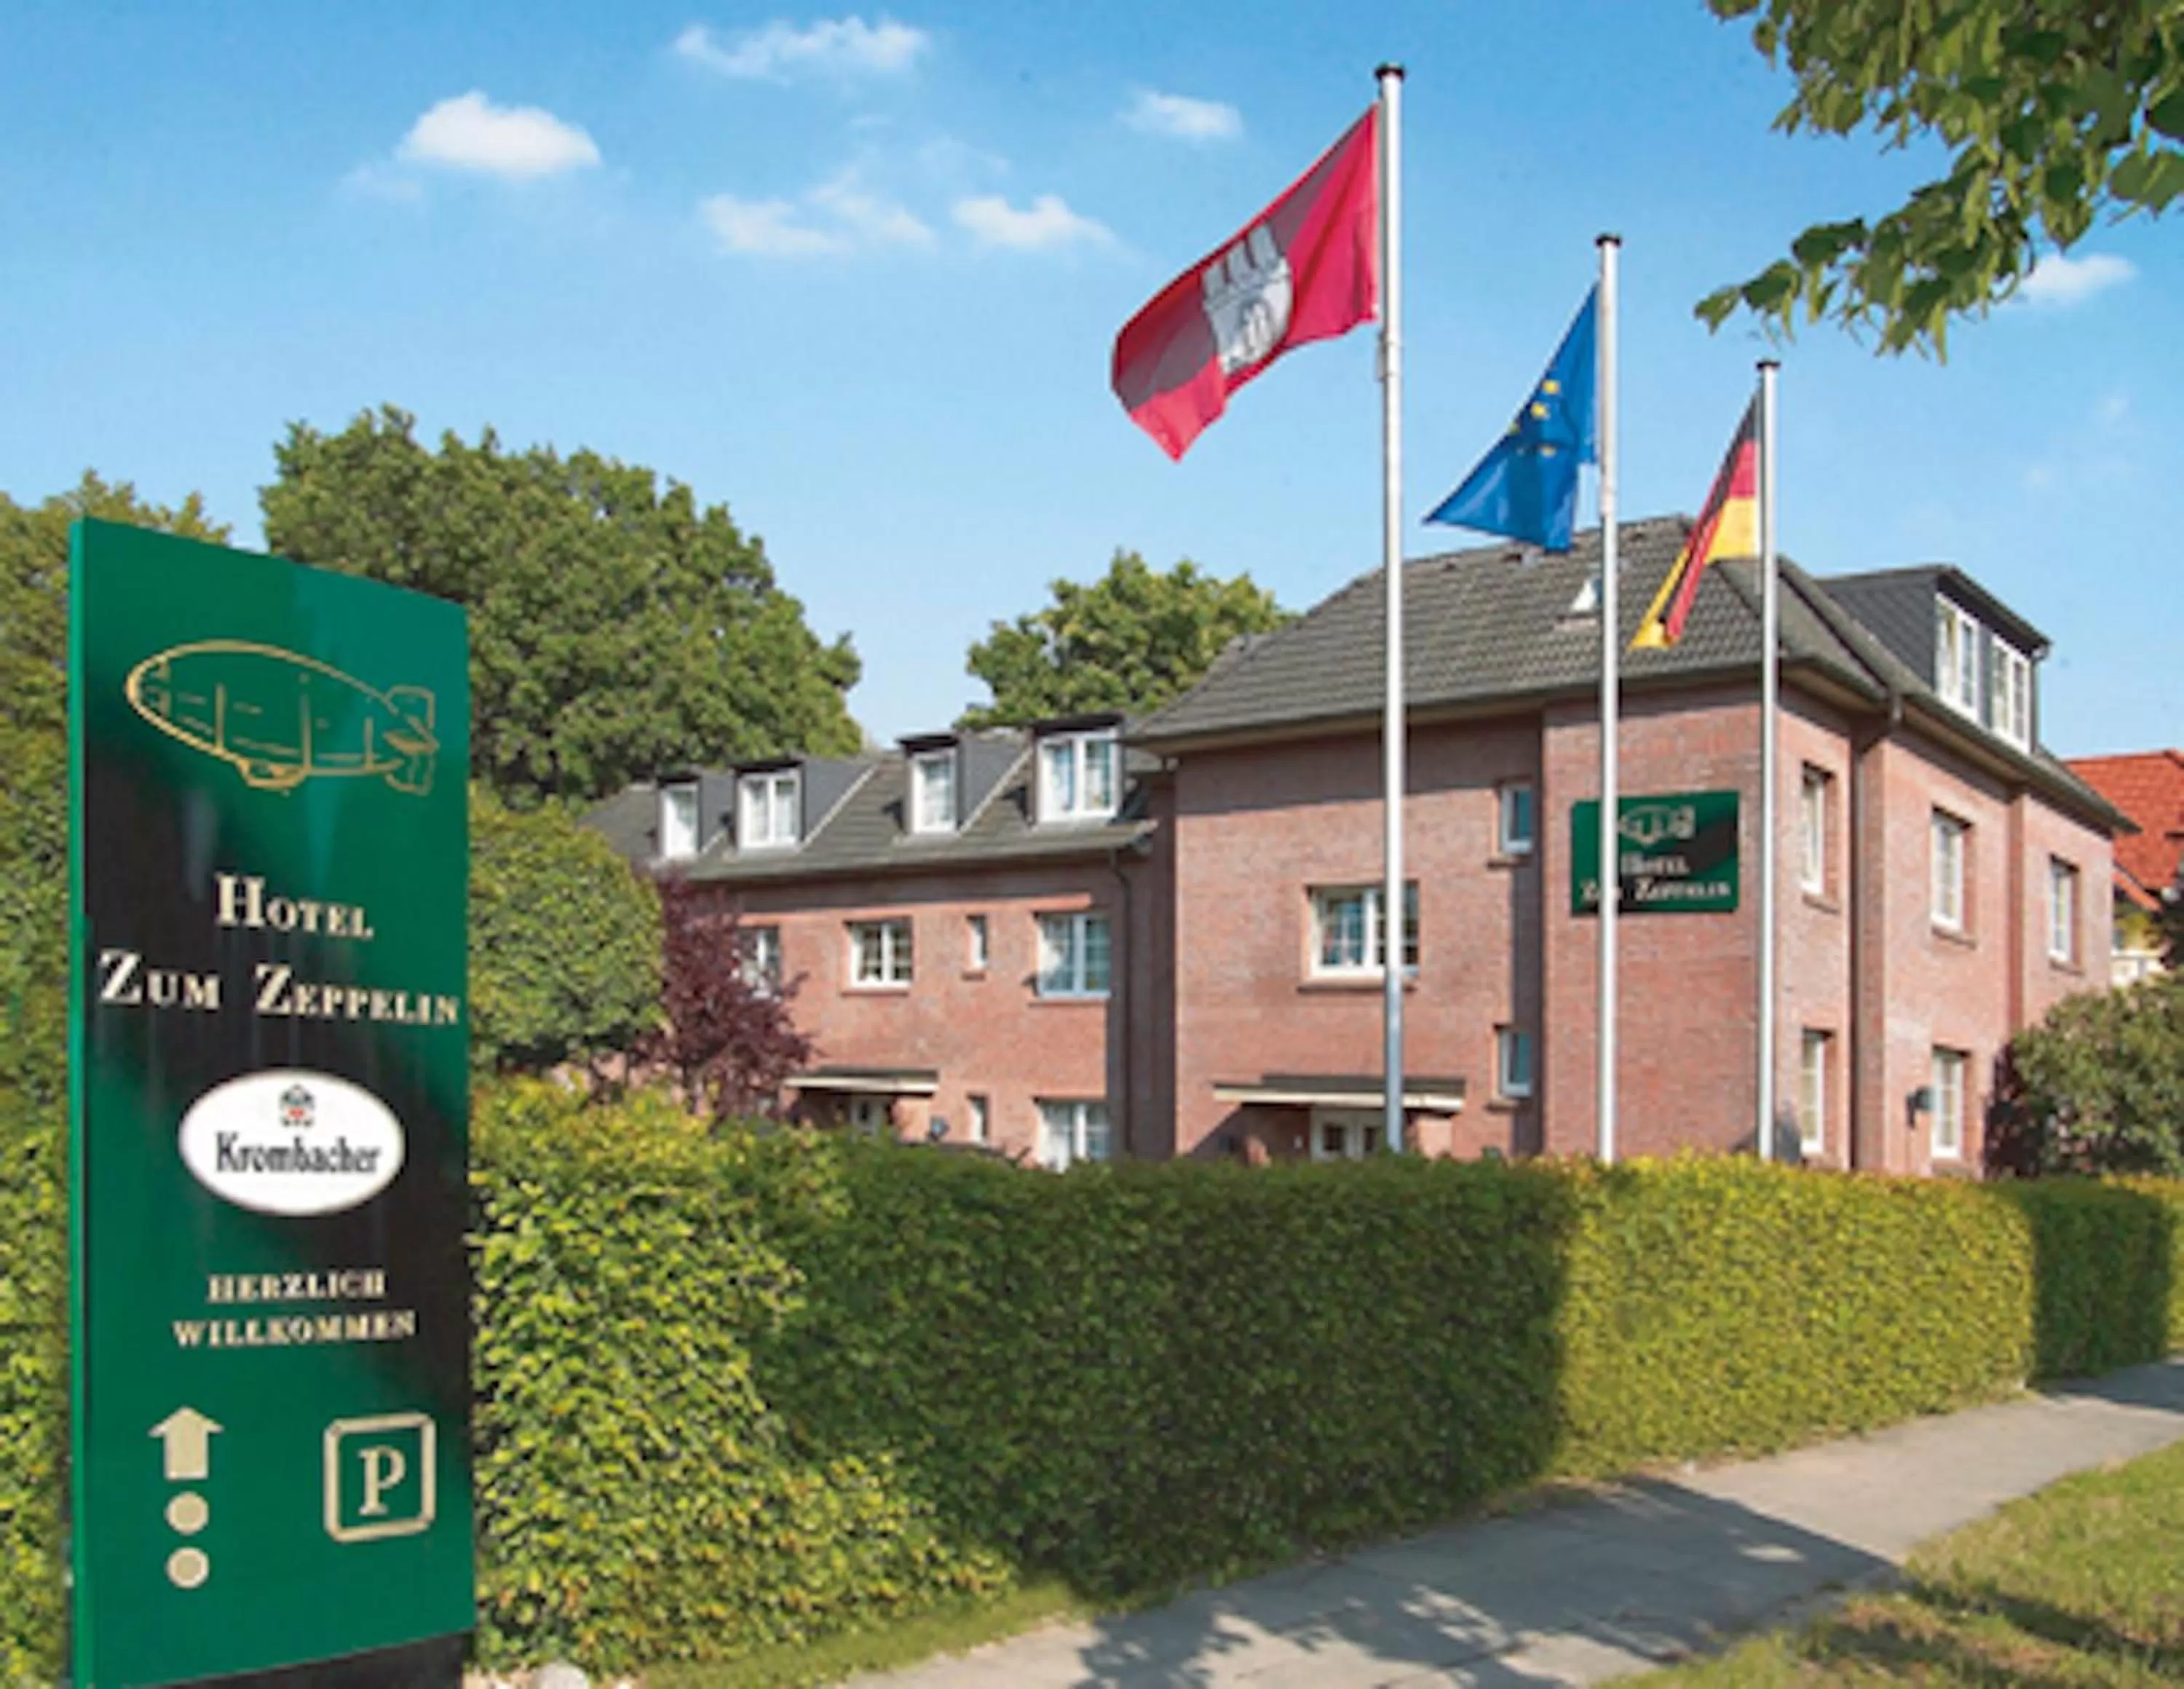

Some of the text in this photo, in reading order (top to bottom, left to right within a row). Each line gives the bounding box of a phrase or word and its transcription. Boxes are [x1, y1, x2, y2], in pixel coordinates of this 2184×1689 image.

[215, 873, 373, 938] HOTEL
[99, 951, 459, 1025] ZUM ZEPPELIN
[215, 1131, 381, 1173] Krombacher
[207, 1270, 386, 1302] HERZLICH
[173, 1311, 416, 1348] WILLKOMMEN
[358, 1445, 406, 1516] P
